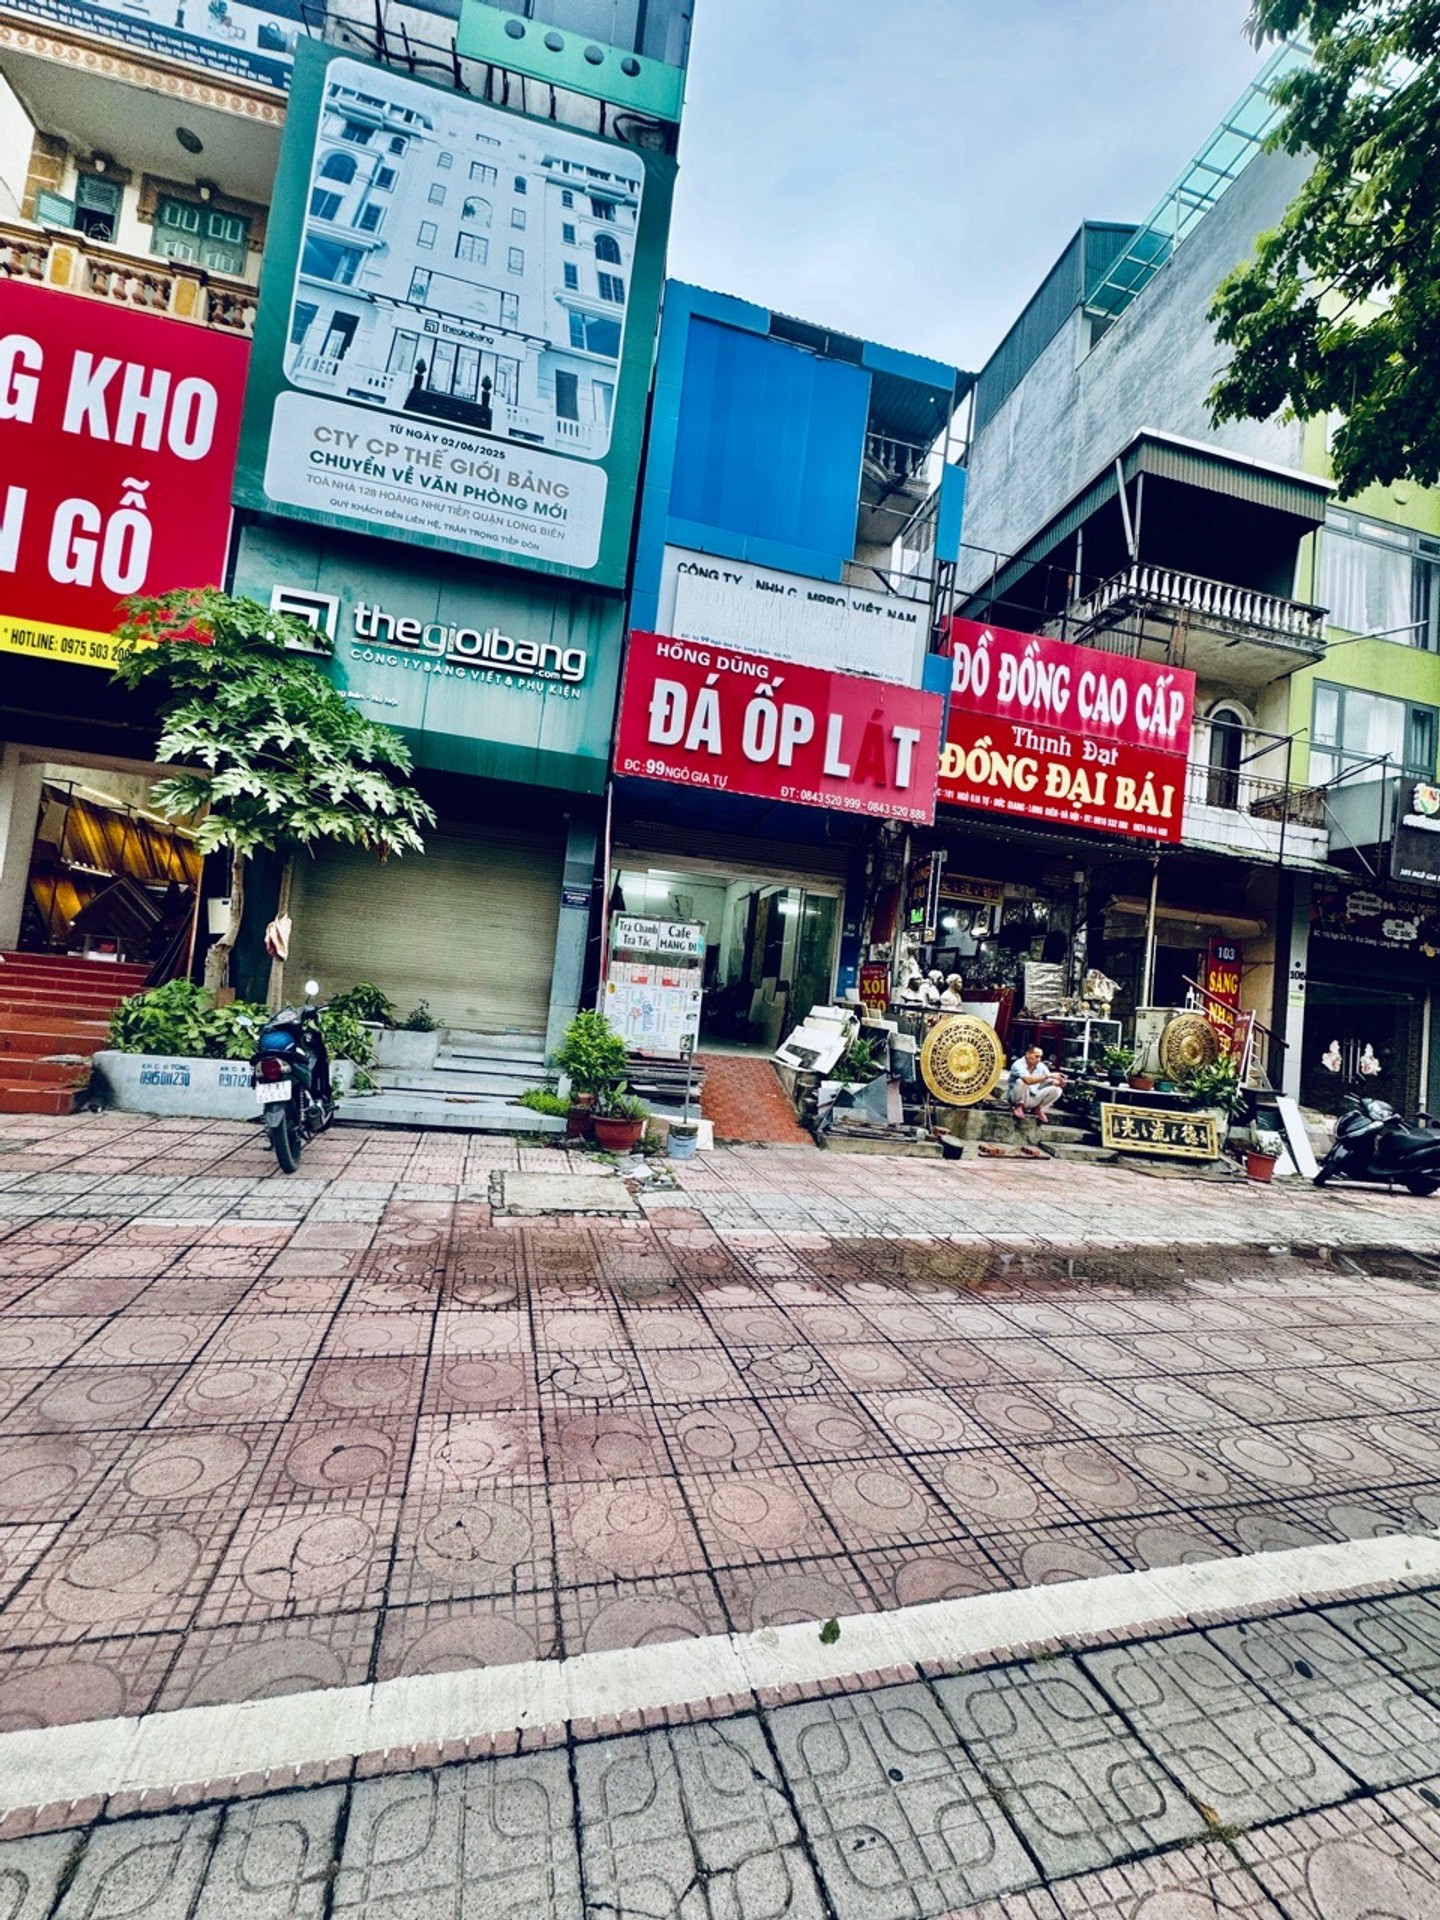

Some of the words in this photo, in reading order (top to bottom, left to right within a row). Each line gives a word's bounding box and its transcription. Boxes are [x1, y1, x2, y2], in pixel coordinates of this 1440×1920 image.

[62, 349, 219, 460] KHO
[313, 425, 360, 450] CTY
[366, 438, 400, 458] CP
[404, 445, 449, 471] THẾ
[450, 459, 501, 484] GIỚI
[507, 469, 571, 500] BẢNG
[405, 428, 439, 443] NGÀY
[440, 437, 506, 460] 02/06/2025
[309, 449, 387, 479] CHUYỂN
[391, 465, 415, 486] VỀ
[419, 473, 459, 495] VĂN
[463, 484, 529, 511] PHÒNG
[533, 501, 569, 521] MỚI
[331, 479, 356, 493] NHÀ
[359, 486, 378, 498] 128
[379, 489, 420, 507] HOÀNG
[506, 519, 538, 534] LONG
[539, 526, 567, 541] BIÊN
[47, 476, 153, 596] GỖ
[722, 572, 743, 586] TY
[887, 609, 917, 624] NAM
[10, 628, 57, 652] HOTLINE:
[60, 637, 88, 656] 0975
[89, 644, 110, 660] 503
[656, 641, 710, 667] HỒNG
[715, 656, 769, 679] DŨNG
[350, 646, 399, 667] CÔNG
[402, 659, 425, 672] TY
[423, 660, 466, 680] BẢNG
[504, 674, 514, 687] &
[517, 678, 544, 695] PHỤ
[548, 682, 581, 700] KIỆN
[952, 629, 994, 697] ĐỒ
[997, 640, 1070, 714] ĐỒNG
[1077, 671, 1128, 726] CAO
[1135, 674, 1184, 737] CẤP
[648, 673, 722, 755] ĐÁ
[742, 676, 815, 767] ỐP
[823, 709, 921, 789] LÁT
[1011, 725, 1071, 757] Thịnh
[1082, 740, 1119, 767] Đạt
[691, 773, 710, 784] GIA
[938, 735, 1039, 792] ĐỒNG
[1044, 762, 1108, 809] ĐẠI
[1114, 771, 1175, 818] BÁI
[800, 790, 824, 804] 0843
[824, 793, 841, 807] 520
[842, 796, 861, 810] 999
[867, 800, 890, 815] 0843
[892, 804, 909, 818] 520
[659, 938, 686, 951] MANG
[1218, 947, 1235, 960] 103
[862, 975, 886, 994] XÔI
